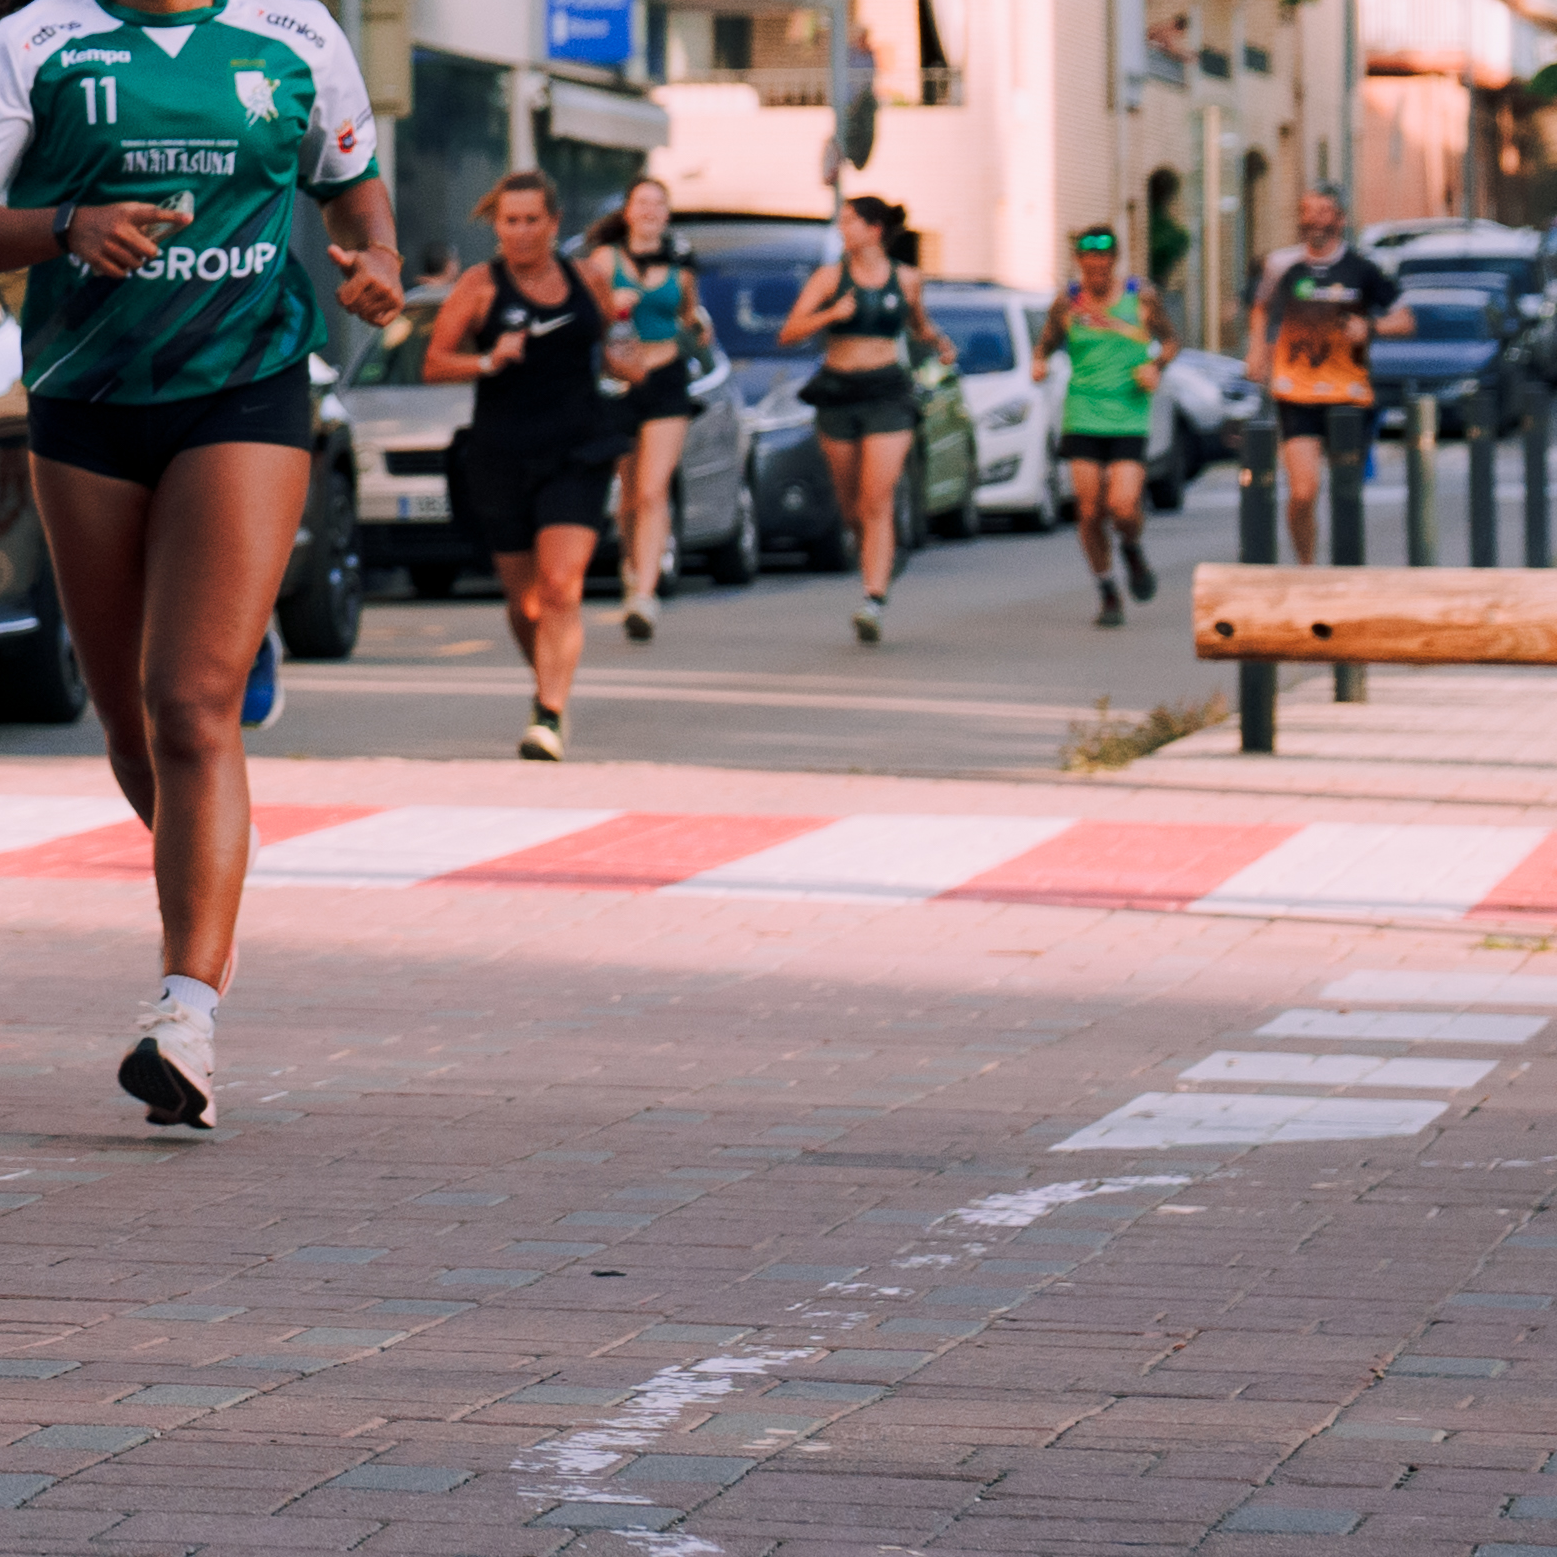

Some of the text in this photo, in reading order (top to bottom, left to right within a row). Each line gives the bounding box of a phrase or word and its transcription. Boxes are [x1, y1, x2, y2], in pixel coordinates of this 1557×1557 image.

[266, 13, 325, 49] athlos
[60, 48, 132, 69] Kempa
[79, 75, 118, 126] 11
